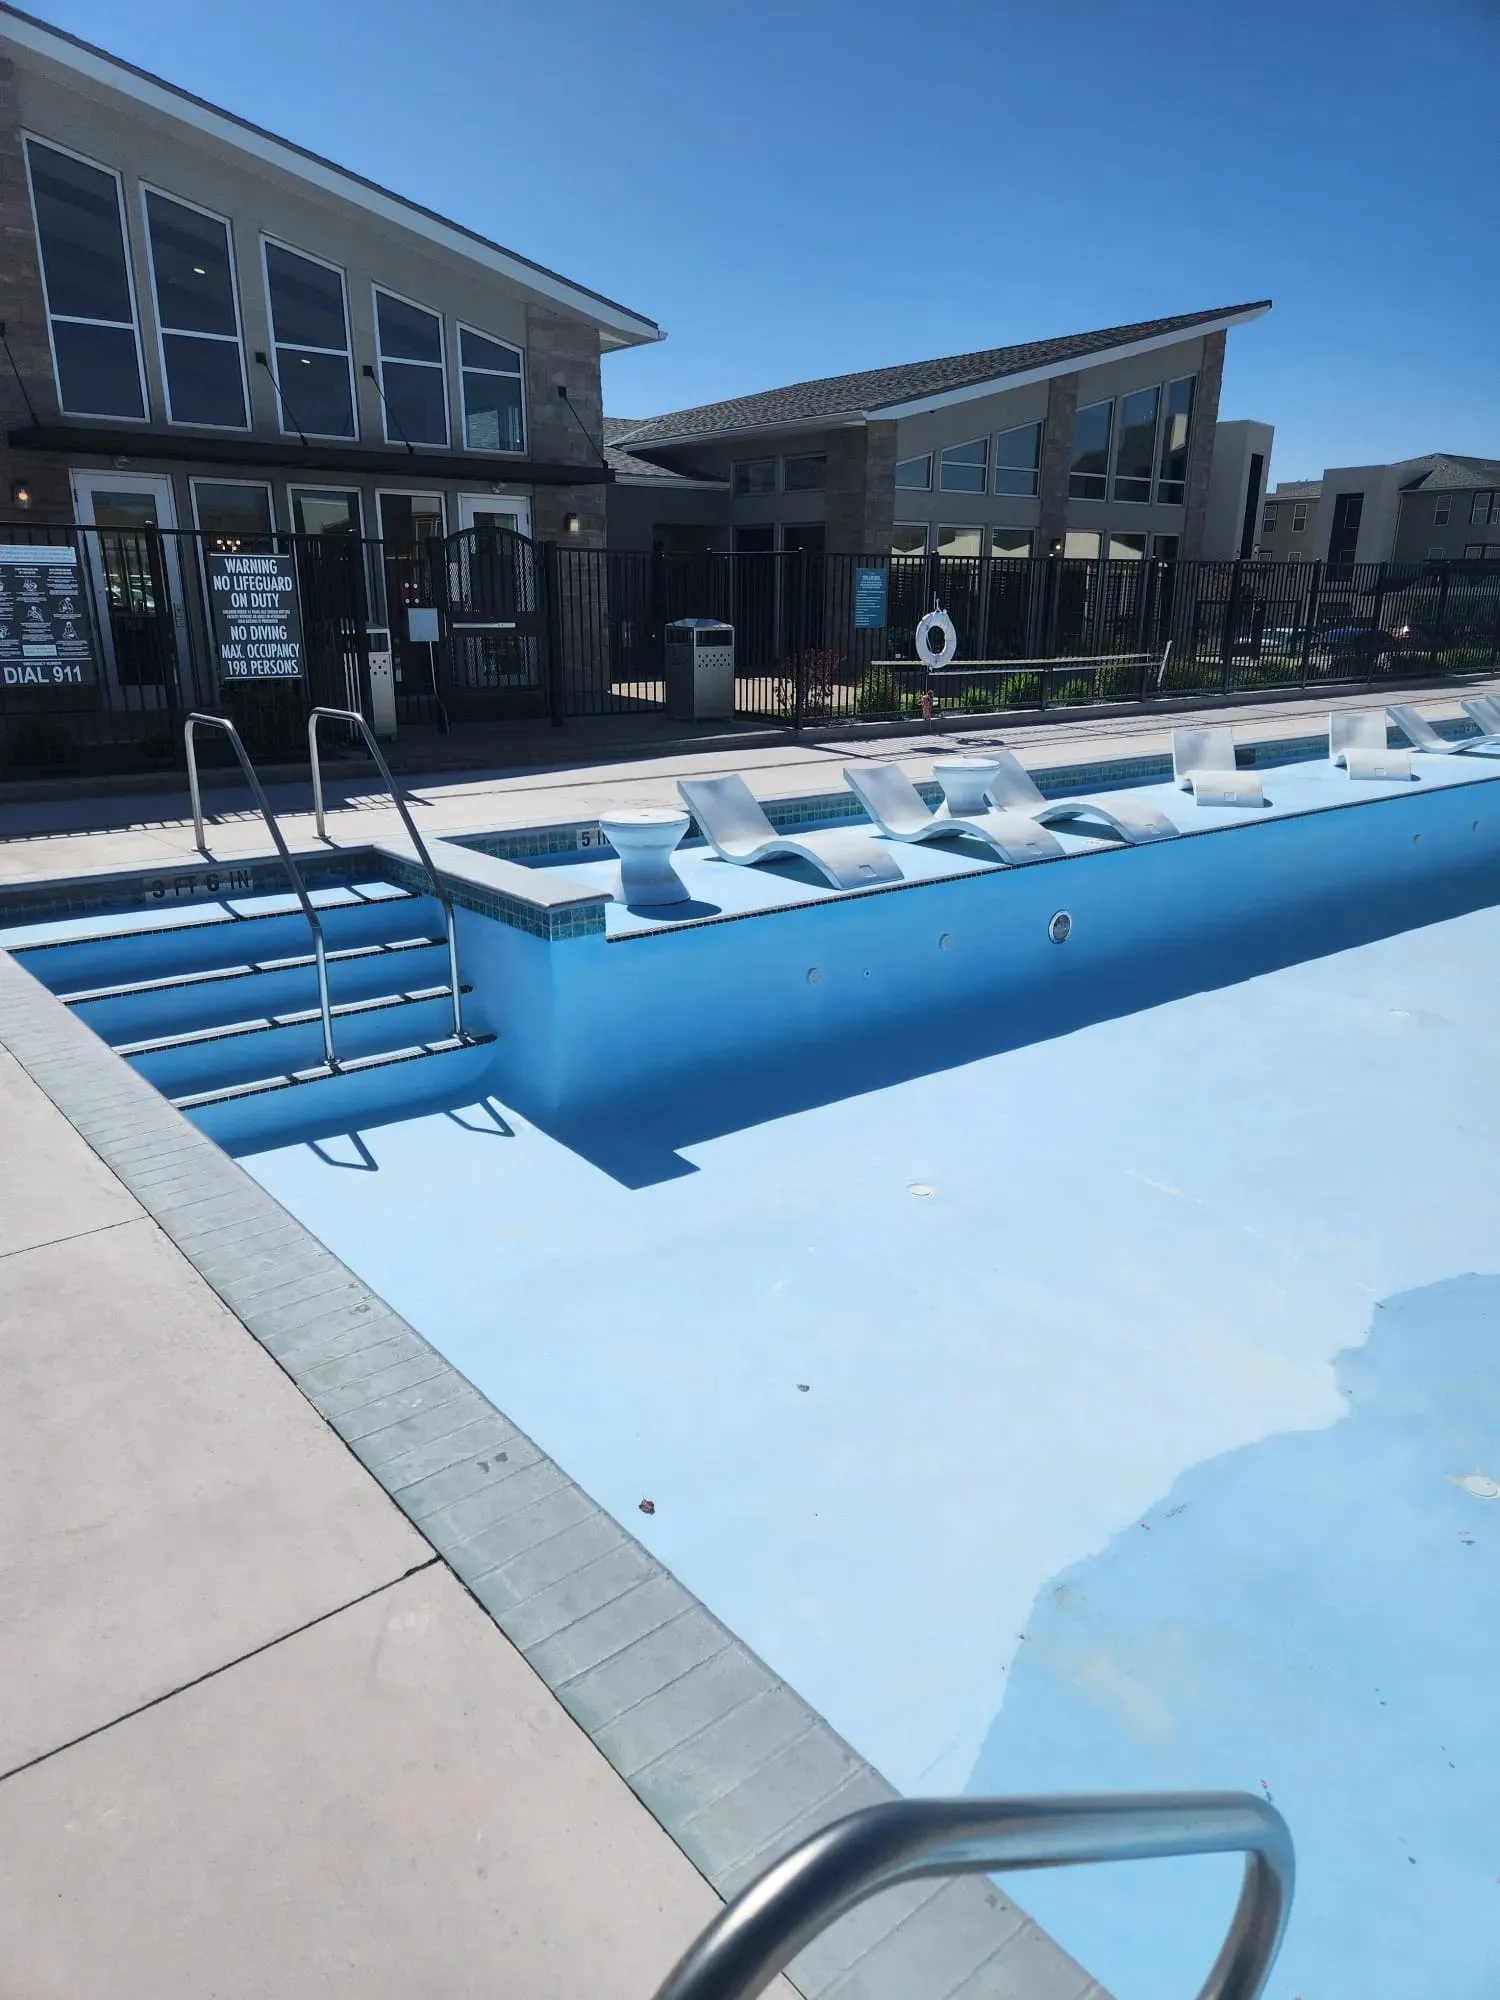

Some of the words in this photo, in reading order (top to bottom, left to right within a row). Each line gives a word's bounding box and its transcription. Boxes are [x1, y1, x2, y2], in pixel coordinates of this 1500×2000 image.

[225, 559, 277, 574] WARNING
[213, 575, 230, 591] NO
[234, 576, 292, 591] LIFEGUARD
[231, 593, 248, 608] ON
[251, 593, 279, 608] DUTY
[231, 626, 247, 640] NO
[250, 626, 287, 640] DIVING
[222, 644, 245, 659] MAX.
[247, 643, 299, 658] OCCUPANCY
[3, 666, 50, 684] DIAL
[52, 665, 82, 683] 911
[227, 660, 248, 676] 198
[251, 660, 298, 675] PERSONS
[581, 831, 590, 847] 5
[152, 880, 165, 898] 3
[174, 876, 196, 896] FT
[206, 874, 219, 892] 6
[230, 870, 249, 890] IN
